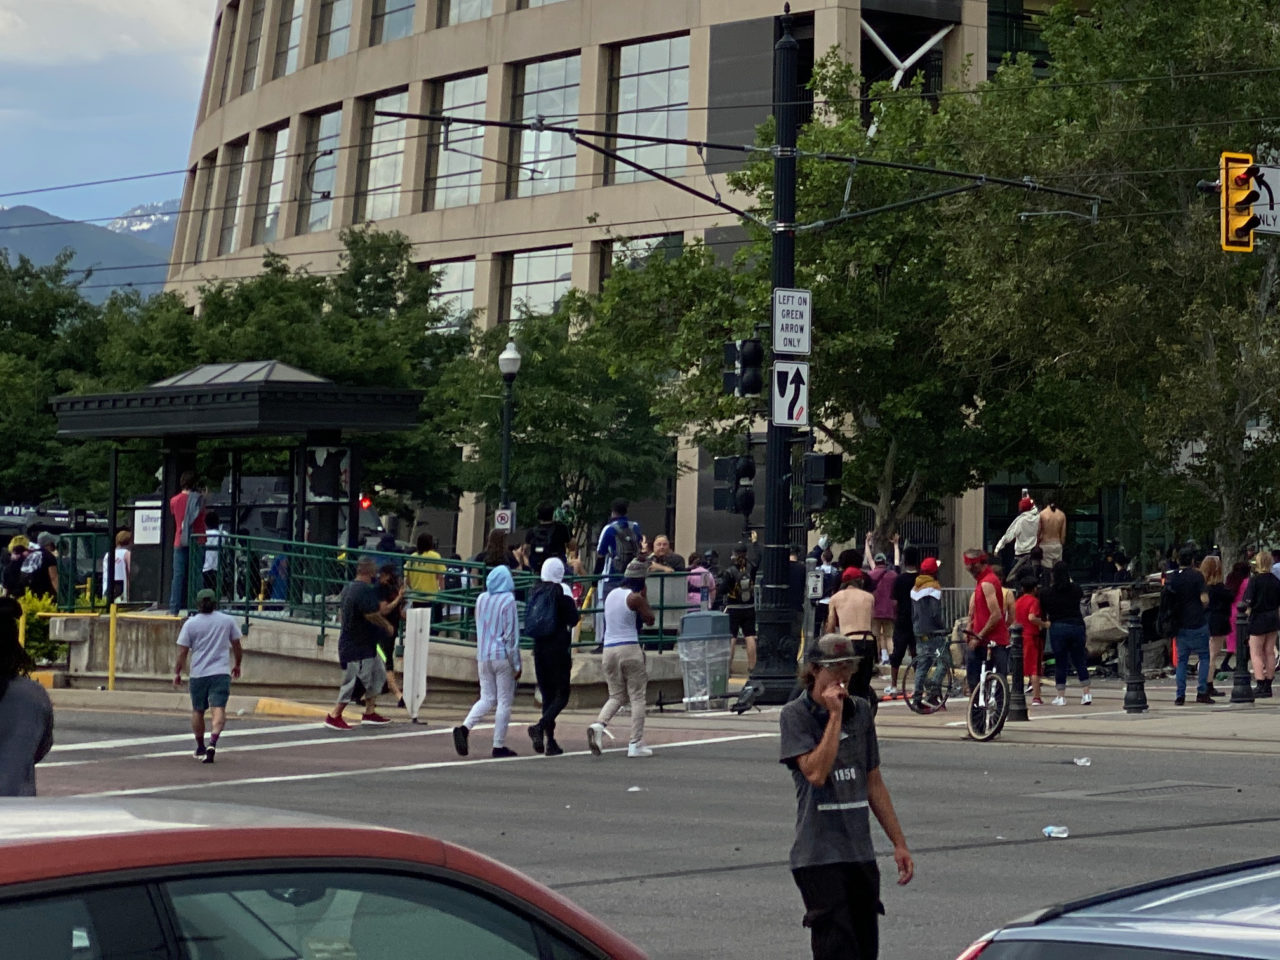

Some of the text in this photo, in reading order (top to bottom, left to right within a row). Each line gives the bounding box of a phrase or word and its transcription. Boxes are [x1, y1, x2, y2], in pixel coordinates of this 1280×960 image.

[1257, 214, 1278, 227] NLY
[778, 295, 807, 306] LEFT ON
[781, 309, 804, 320] GREEN
[780, 324, 804, 334] ARROW
[783, 338, 801, 348] ONLY
